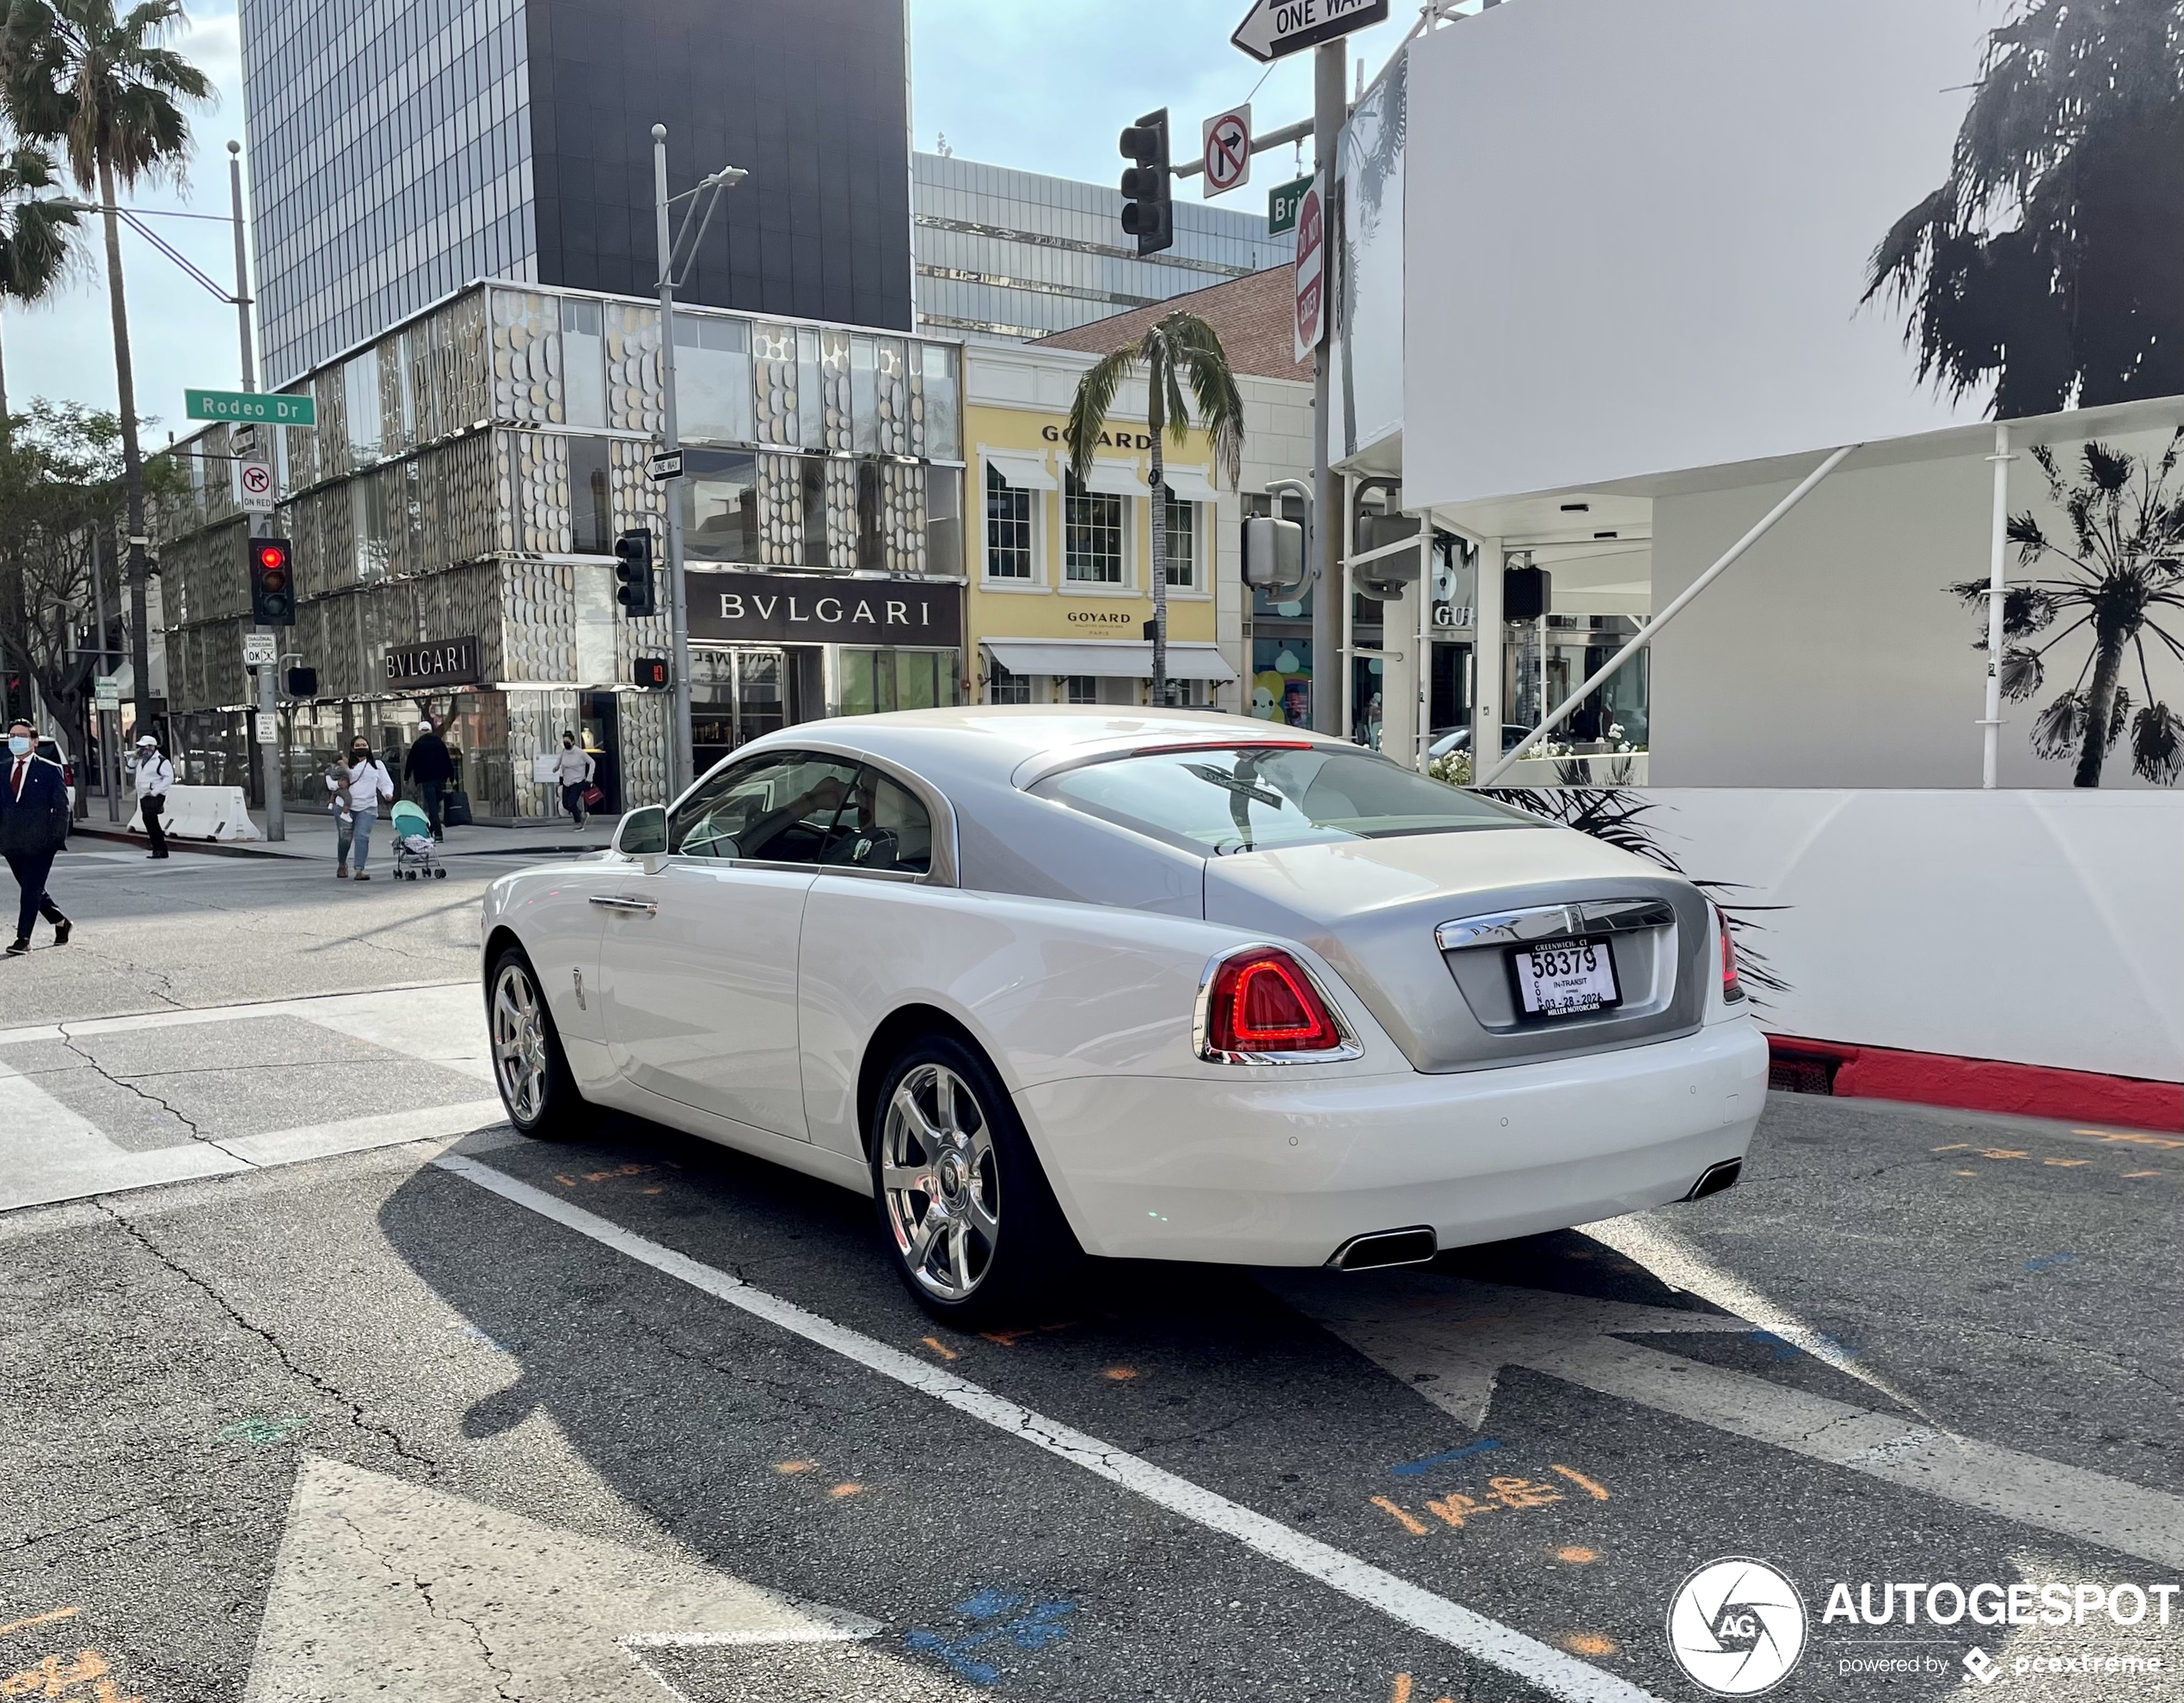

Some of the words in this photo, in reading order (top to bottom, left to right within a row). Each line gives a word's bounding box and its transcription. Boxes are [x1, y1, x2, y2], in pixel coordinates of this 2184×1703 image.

[1277, 0, 1316, 34] ONE
[1299, 229, 1306, 258] DO
[1308, 211, 1319, 244] NOT
[1301, 286, 1316, 325] ENTER
[202, 397, 265, 416] Rodeo
[277, 401, 298, 418] Dr
[654, 461, 666, 472] ONE
[667, 458, 678, 469] WAY
[244, 498, 255, 506] ON
[256, 499, 271, 507] RED
[720, 593, 929, 625] BVLGARI
[1068, 612, 1131, 622] GOYARD
[249, 652, 261, 661] OK
[386, 645, 466, 678] BVLGARI
[1531, 947, 1598, 978] 58379
[1554, 977, 1587, 989] IN-TRANSIT
[1548, 1008, 1567, 1016] MILLER
[1567, 1003, 1600, 1014] MOTORCARS
